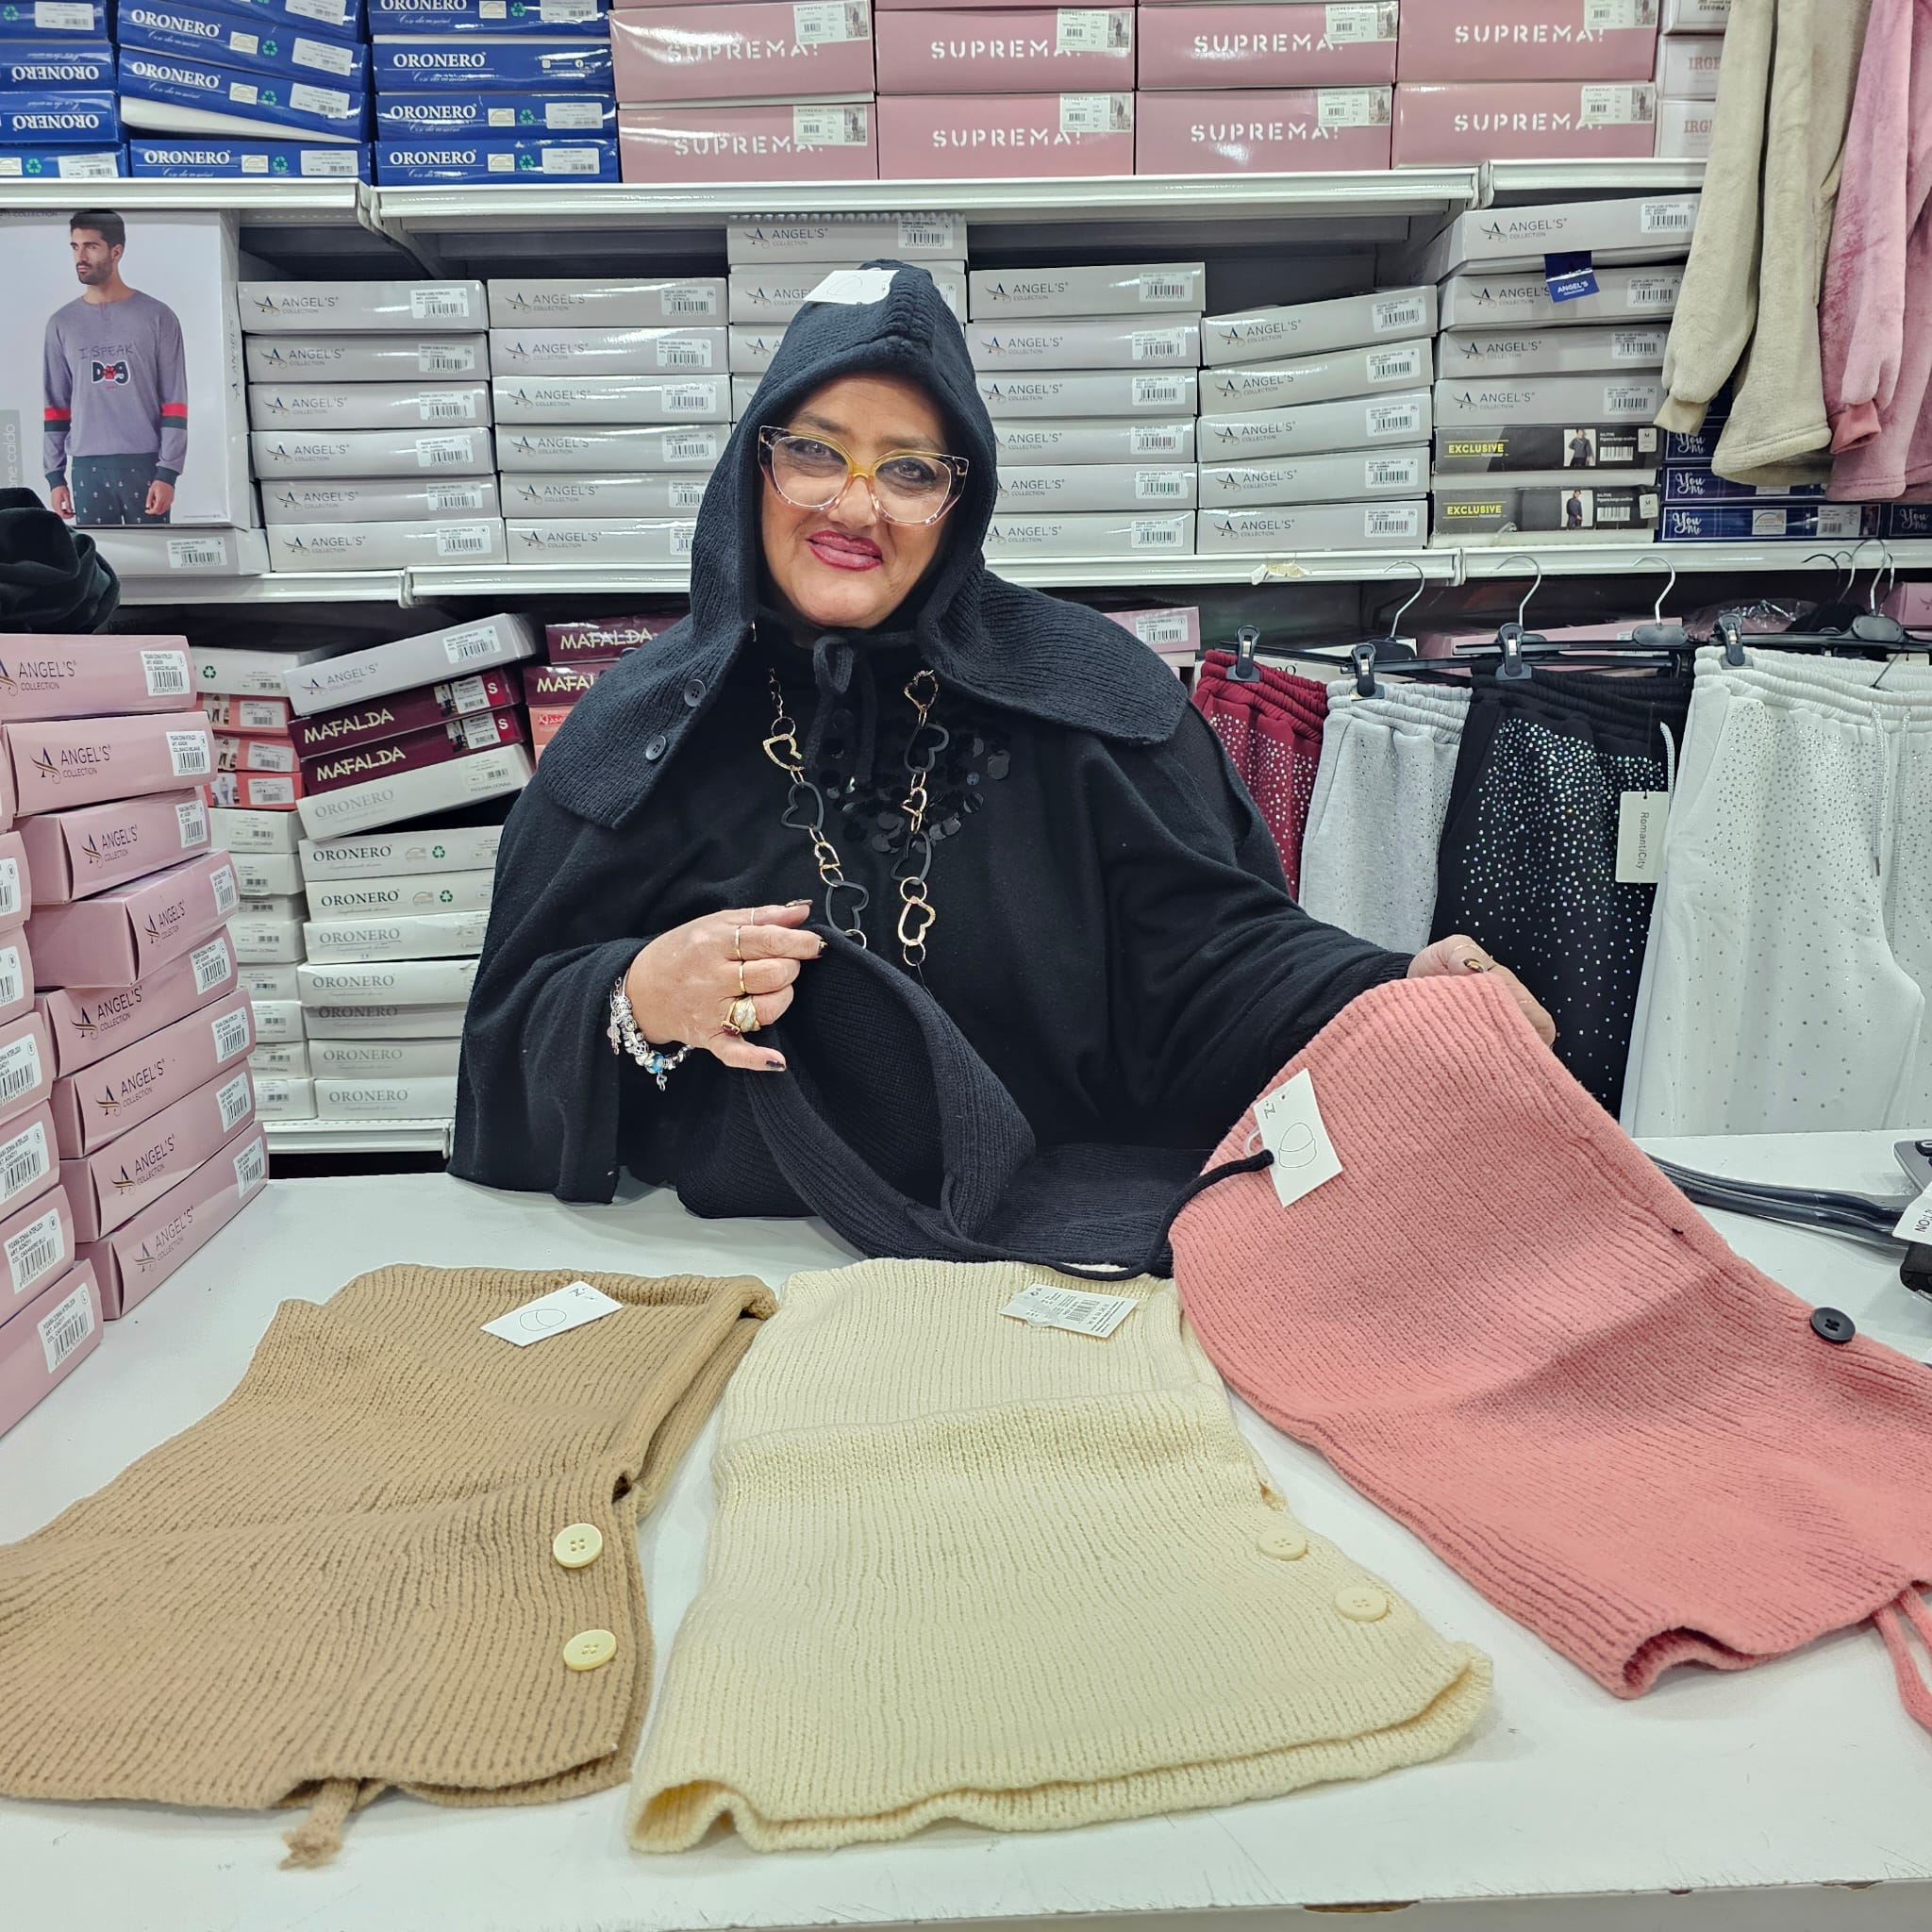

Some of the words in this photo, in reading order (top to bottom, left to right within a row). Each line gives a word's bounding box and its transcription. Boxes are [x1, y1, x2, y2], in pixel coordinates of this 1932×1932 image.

[131, 8, 221, 38] ORONERO
[393, 53, 485, 68] ORONERO
[11, 64, 98, 81] ORONERO
[132, 60, 221, 90] ORONERO
[390, 105, 475, 119] ORONERO
[12, 113, 98, 129] ORONERO
[143, 148, 229, 165] ORONERO
[390, 150, 475, 164] ORONERO
[1509, 218, 1564, 232] ANGEL'S
[772, 228, 825, 239] ANGEL'S
[774, 288, 811, 299] ANGE
[1013, 282, 1066, 294] ANGEL'S
[1557, 280, 1589, 293] ANGEL'S
[282, 296, 336, 308] ANGEL'S
[1246, 321, 1299, 337] ANGEL'S
[532, 342, 586, 354] ANGEL'S
[1008, 337, 1060, 348] ANGEL'S
[1487, 341, 1540, 353] ANGEL'S
[91, 343, 135, 358] SPEAK
[289, 348, 342, 359] ANGEL'S
[535, 390, 588, 400] ANGEL'S
[1008, 384, 1059, 395] ANGEL'S
[291, 397, 345, 408] ANGEL'S
[1479, 391, 1532, 403] ANGEL'S
[1241, 422, 1293, 435] ANGEL'S
[3, 424, 17, 462] caldo
[1008, 432, 1059, 443] ANGEL'S
[1675, 431, 1706, 453] You
[294, 444, 347, 456] ANGEL'S
[1448, 442, 1505, 454] EXCLUSIVE
[1242, 470, 1294, 483] ANGEL'S
[1674, 473, 1706, 494] You
[543, 485, 597, 496] ANGEL'S
[1010, 479, 1062, 490] ANGEL'S
[304, 491, 357, 502] ANGEL'S
[1446, 505, 1502, 515] EXCLUSIVE
[1241, 520, 1292, 530] ANGEL'S
[1673, 512, 1702, 534] You
[1900, 508, 1929, 530] You
[547, 531, 599, 542] ANGEL'S
[1008, 525, 1058, 537] ANGEL'S
[311, 536, 363, 547] ANGEL'S
[560, 627, 653, 650] MAFALDA
[19, 660, 74, 678] ANGEL'S
[326, 664, 376, 685] ANGEL'S
[488, 682, 498, 694] S
[305, 708, 394, 743] MAFALDA
[498, 718, 509, 730] S
[60, 745, 109, 765] ANGEL'S
[317, 745, 406, 782] MAFALDA
[315, 789, 393, 818] ORONERO
[102, 825, 138, 849] ANGEL'S
[1635, 811, 1650, 870] RomantiCity
[313, 845, 391, 862] ORONERO
[321, 890, 399, 907] ORONERO
[158, 901, 184, 927] ANGEL'S
[319, 927, 400, 943] ORONERO
[312, 974, 394, 989] ORONERO
[98, 987, 142, 1021] ANGEL'S
[324, 1048, 403, 1061] ORONERO
[121, 1060, 164, 1097] ANGEL'S
[329, 1089, 408, 1103] ORONERO
[135, 1136, 175, 1174] ANGEL'S
[156, 1208, 194, 1252] ANGEL'S
